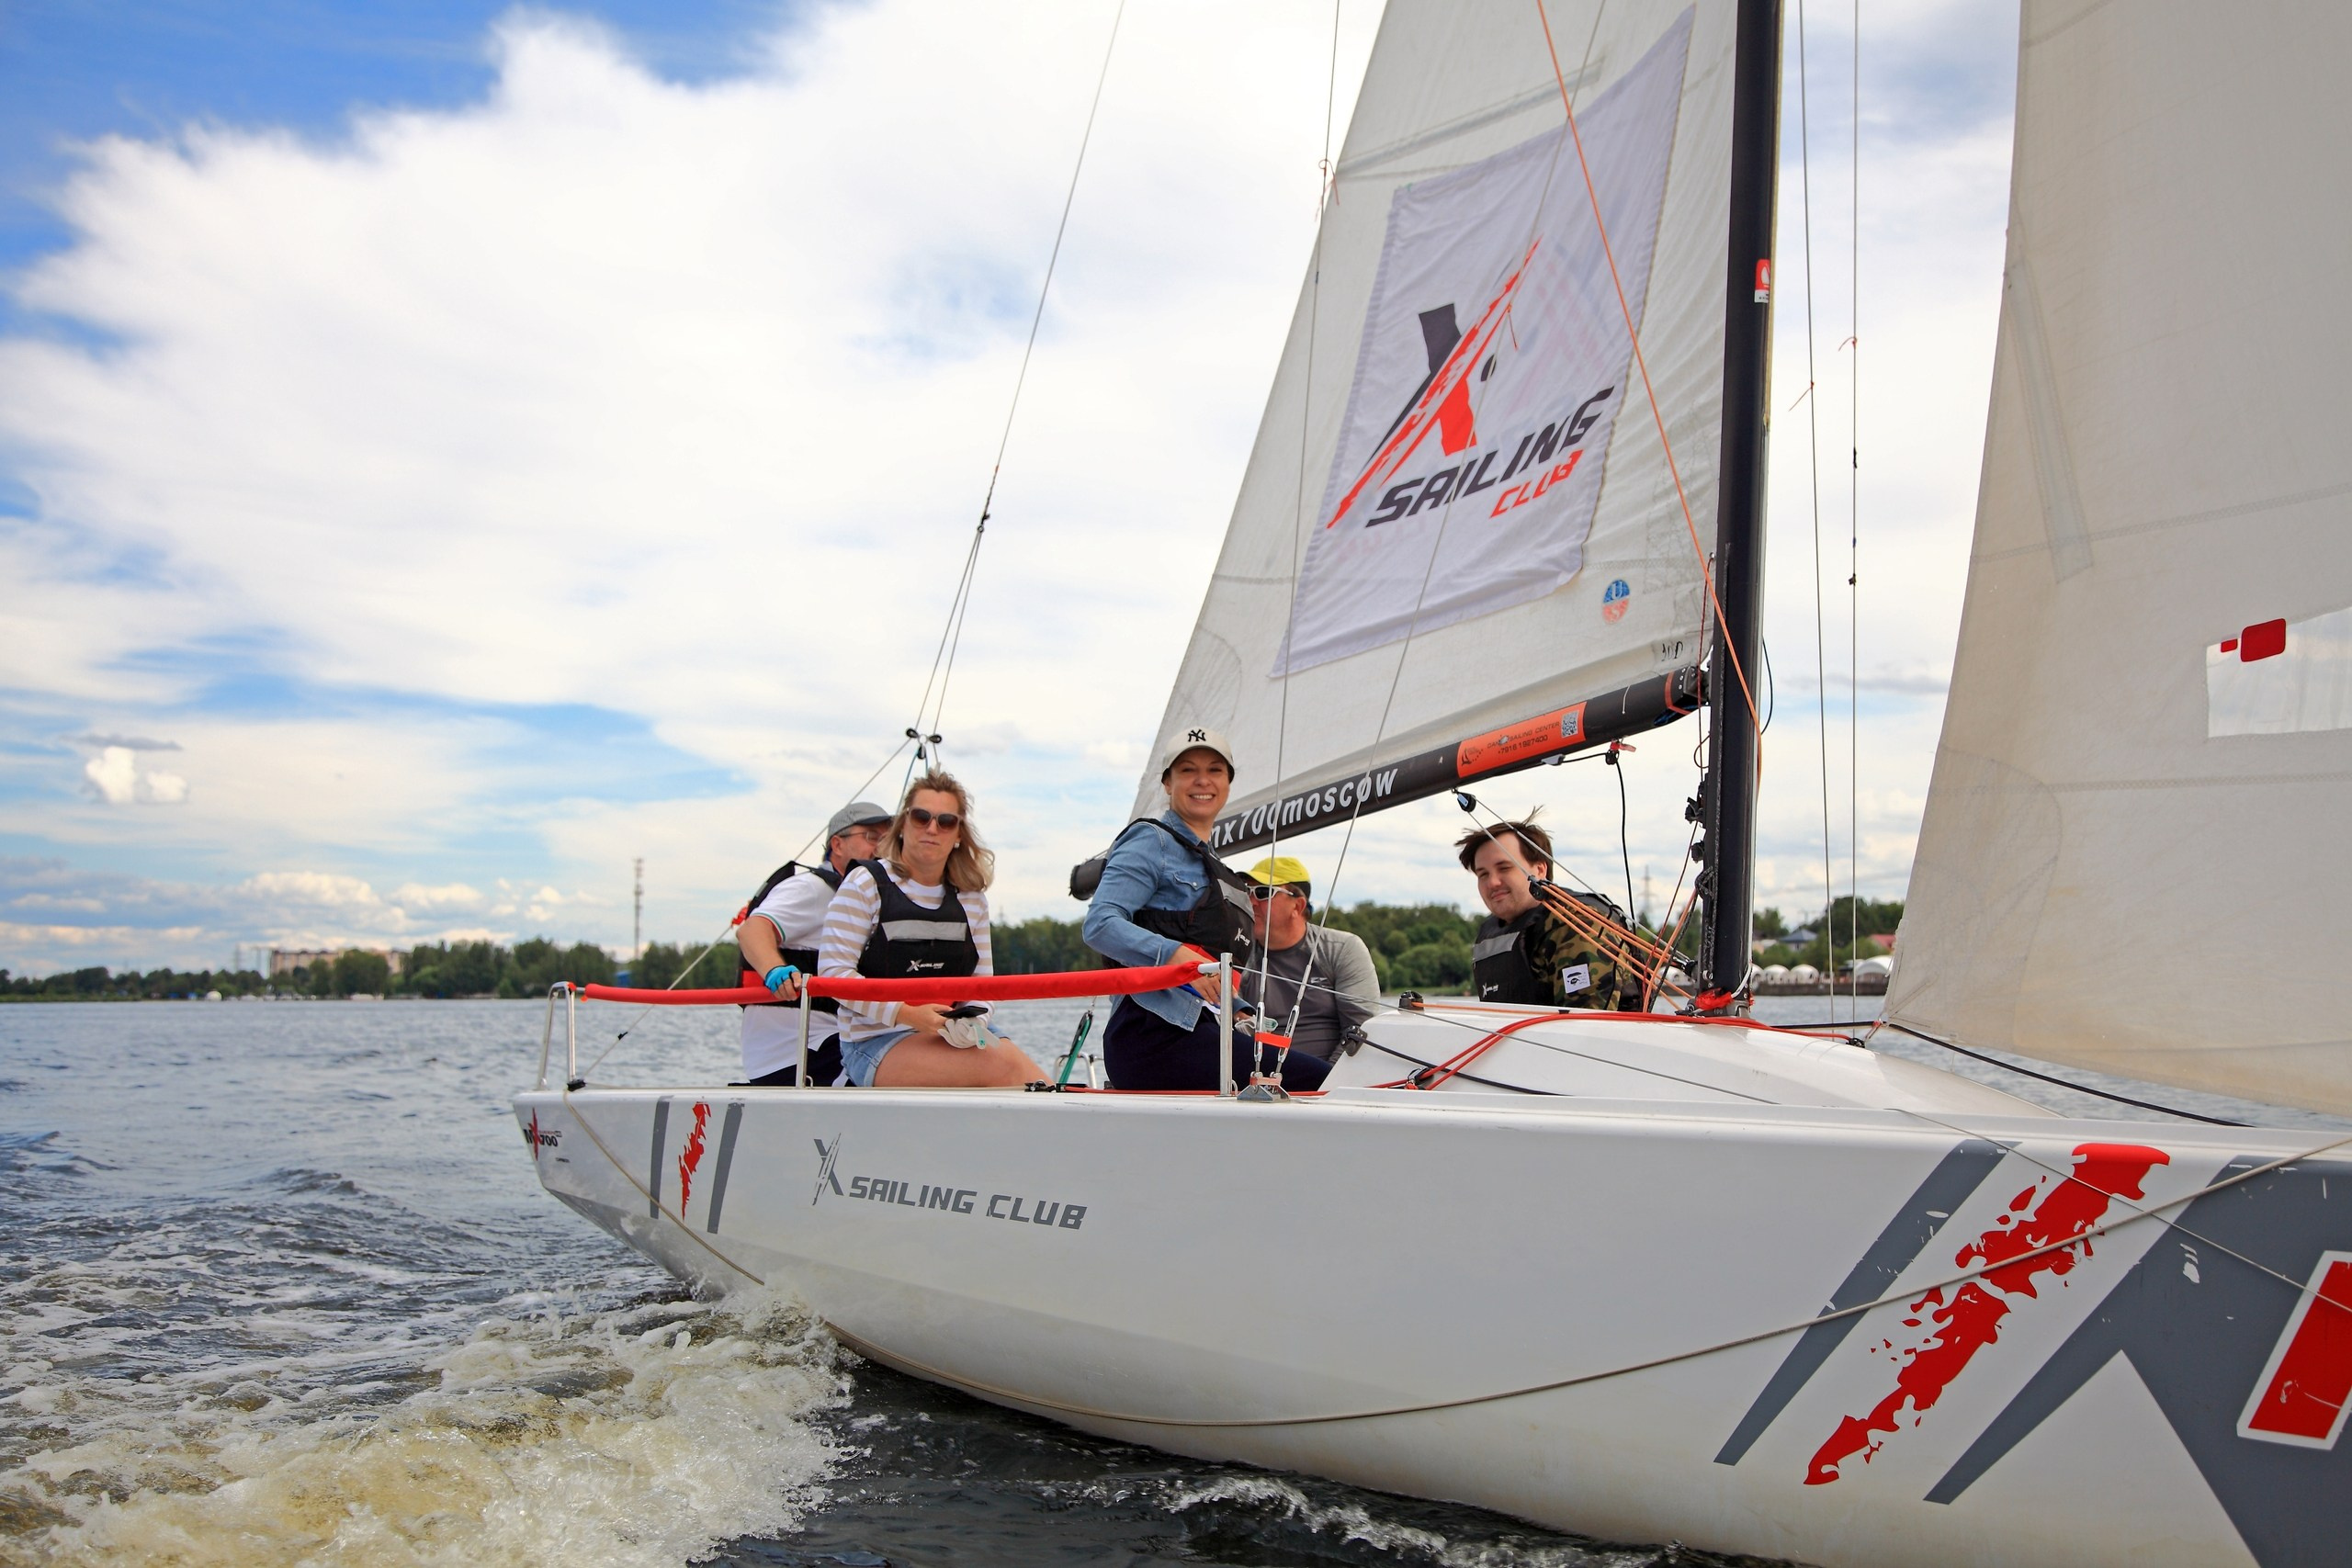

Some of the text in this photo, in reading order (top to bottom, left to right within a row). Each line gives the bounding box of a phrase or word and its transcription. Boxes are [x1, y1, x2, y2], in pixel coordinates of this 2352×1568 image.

[1365, 385, 1615, 528] SAILING
[1489, 449, 1584, 519] CLUB
[1188, 728, 1206, 742] NY
[1534, 721, 1560, 734] CENTER
[849, 1176, 978, 1214] SAILING
[986, 1194, 1088, 1230] CLUB
